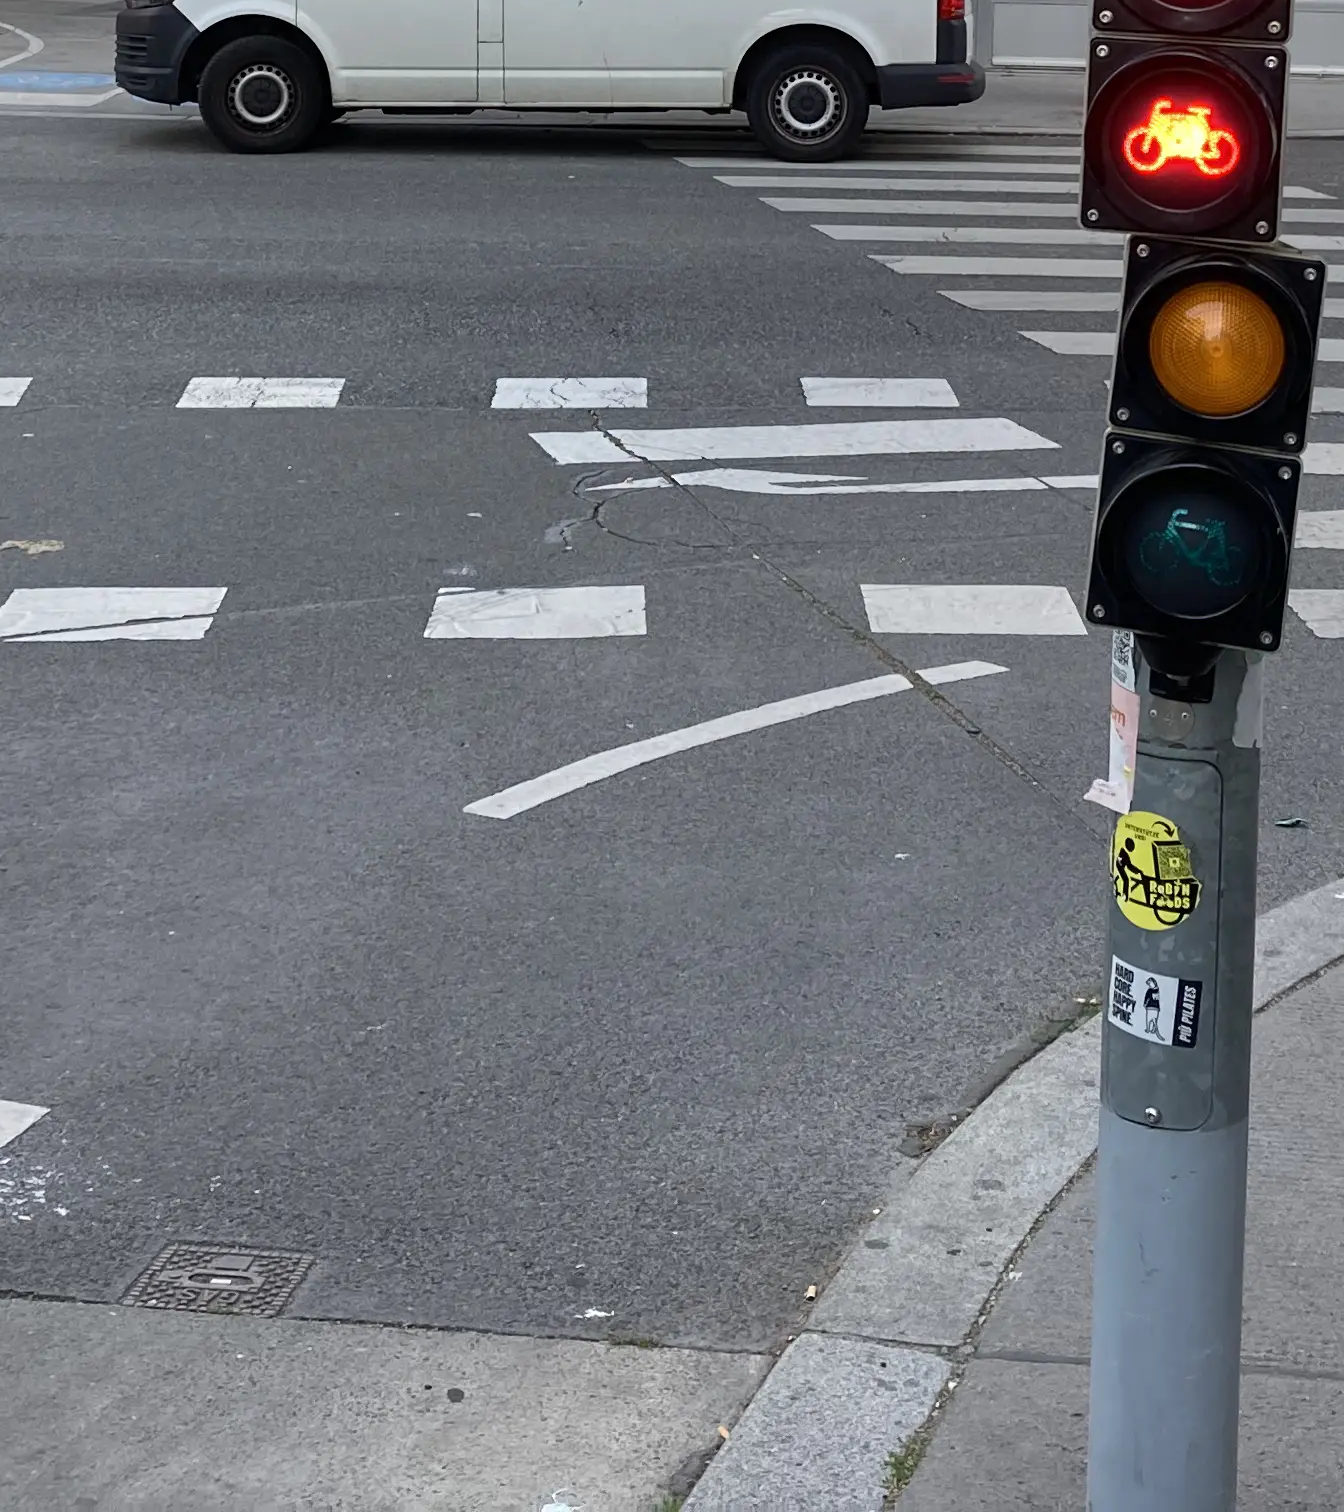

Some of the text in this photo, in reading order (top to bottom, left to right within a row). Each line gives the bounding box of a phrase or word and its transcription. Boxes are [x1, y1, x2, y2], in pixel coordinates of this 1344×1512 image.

[1115, 962, 1135, 984] HARD
[1113, 988, 1137, 1014] HAPPY
[1181, 984, 1197, 1025] PILATES
